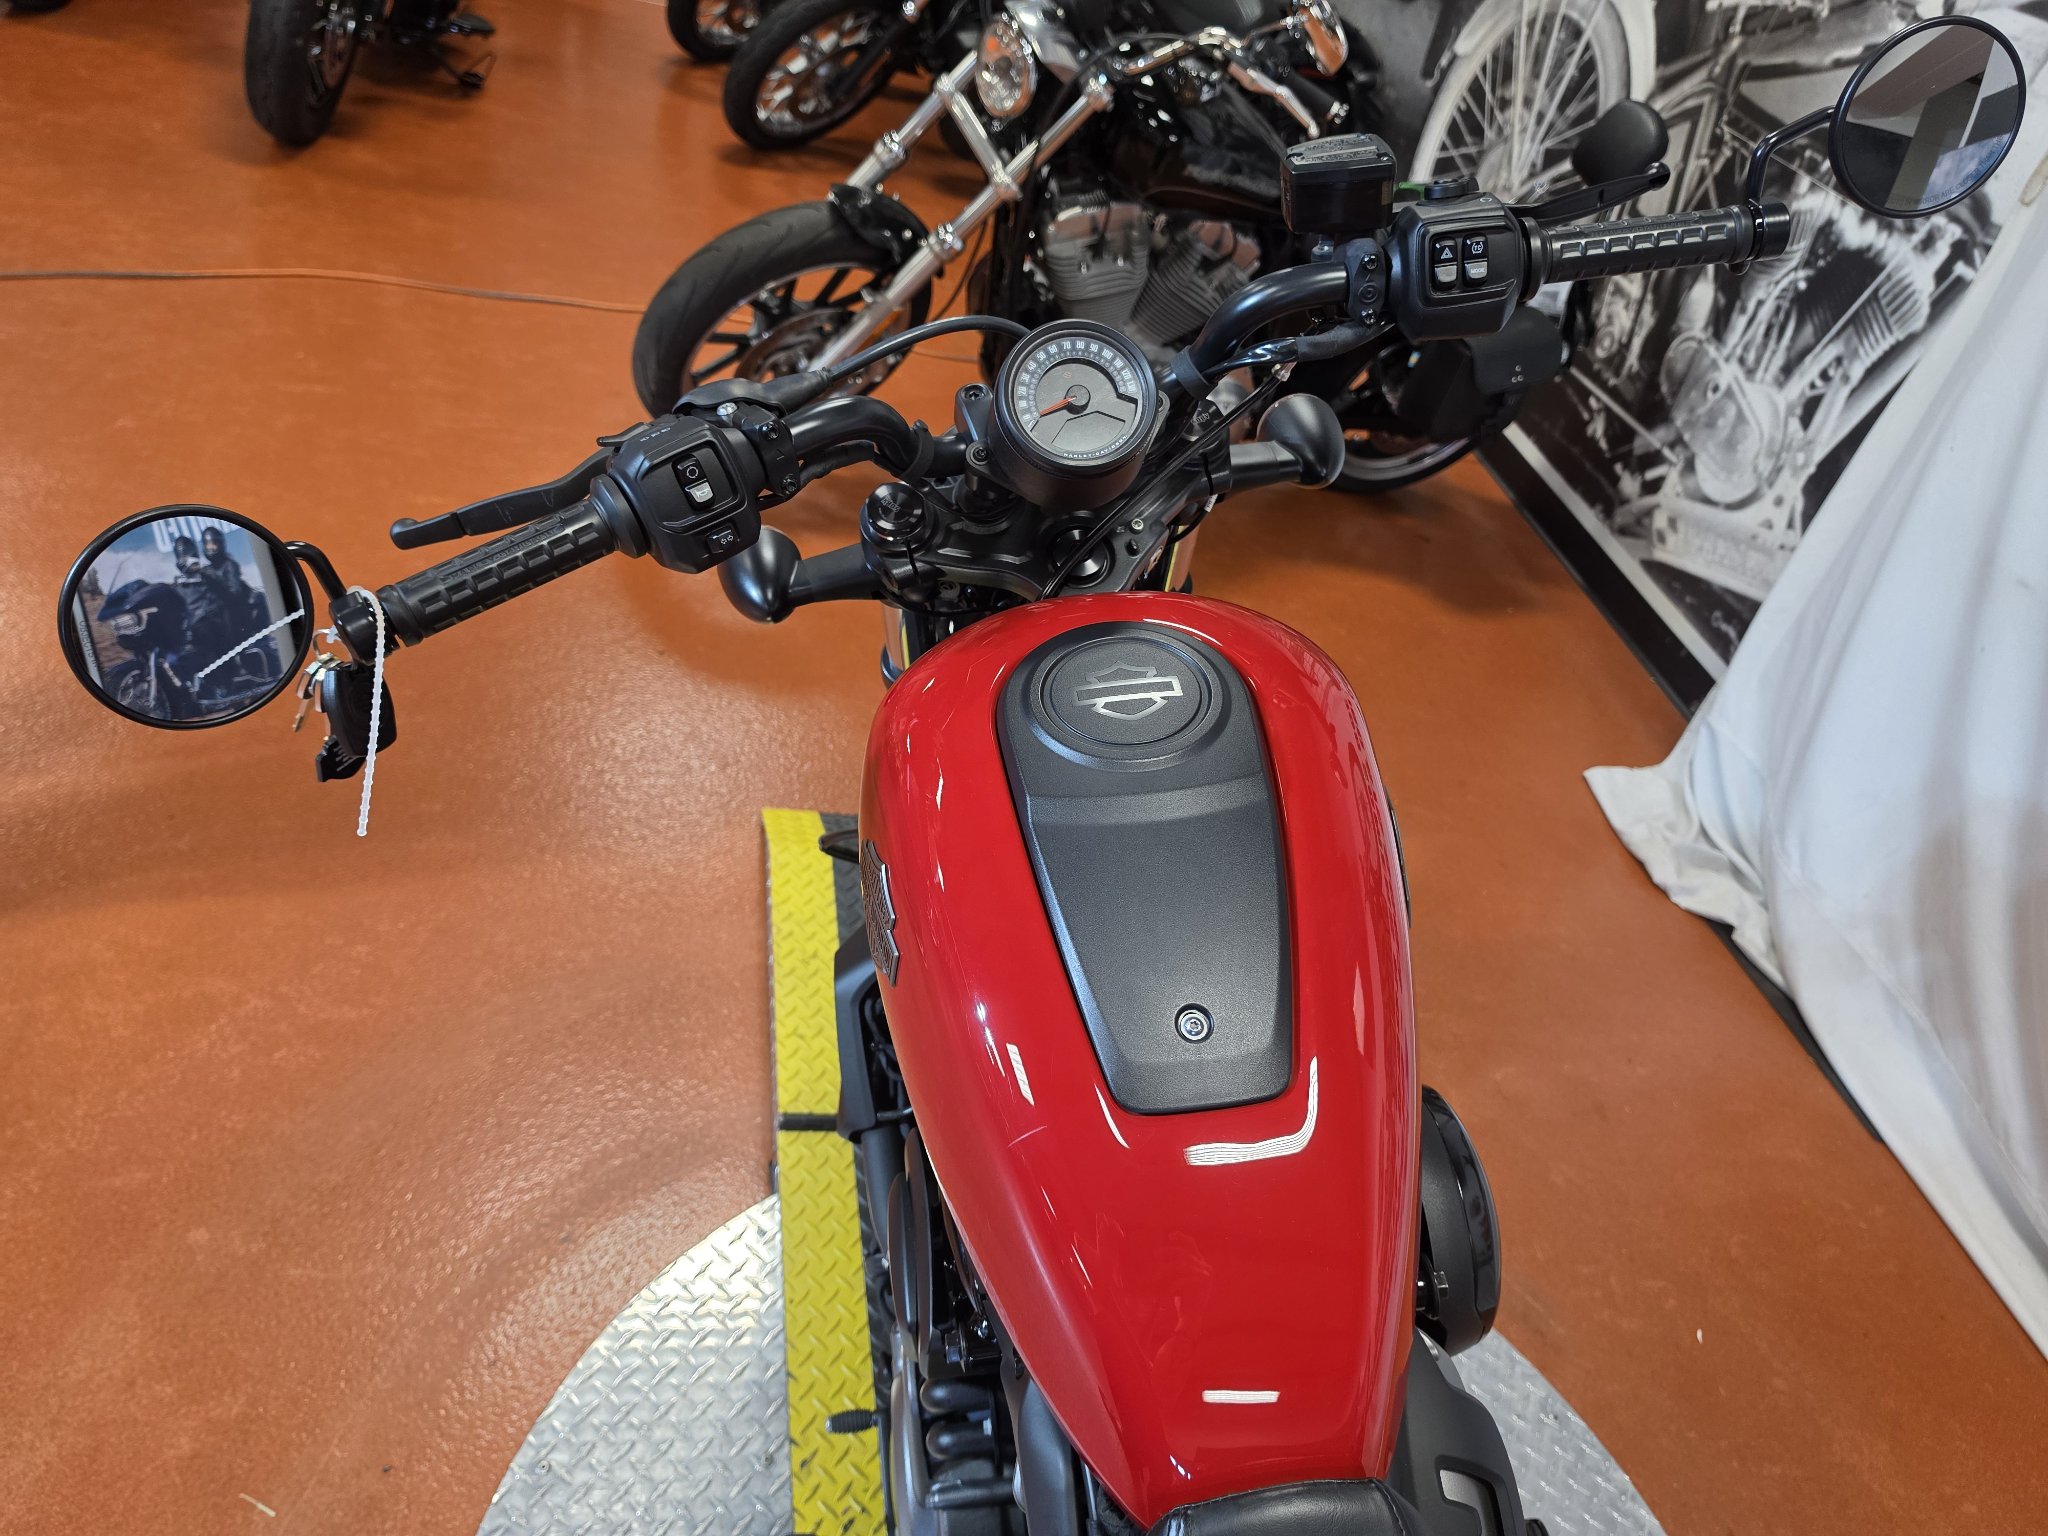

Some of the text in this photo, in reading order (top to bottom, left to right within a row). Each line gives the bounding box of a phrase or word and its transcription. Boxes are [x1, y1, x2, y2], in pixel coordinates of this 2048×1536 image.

[1048, 344, 1058, 354] 60
[1062, 341, 1071, 350] 70
[1076, 340, 1085, 349] 80
[1089, 343, 1099, 352] 90
[1037, 351, 1046, 361] 50
[1102, 348, 1113, 359] 100
[1027, 360, 1036, 370] 40
[1114, 358, 1124, 368] 110
[1021, 372, 1030, 383] 30
[1121, 368, 1132, 379] 120
[1018, 386, 1027, 396] 20
[1019, 400, 1028, 408] 10
[1023, 414, 1030, 422] 0
